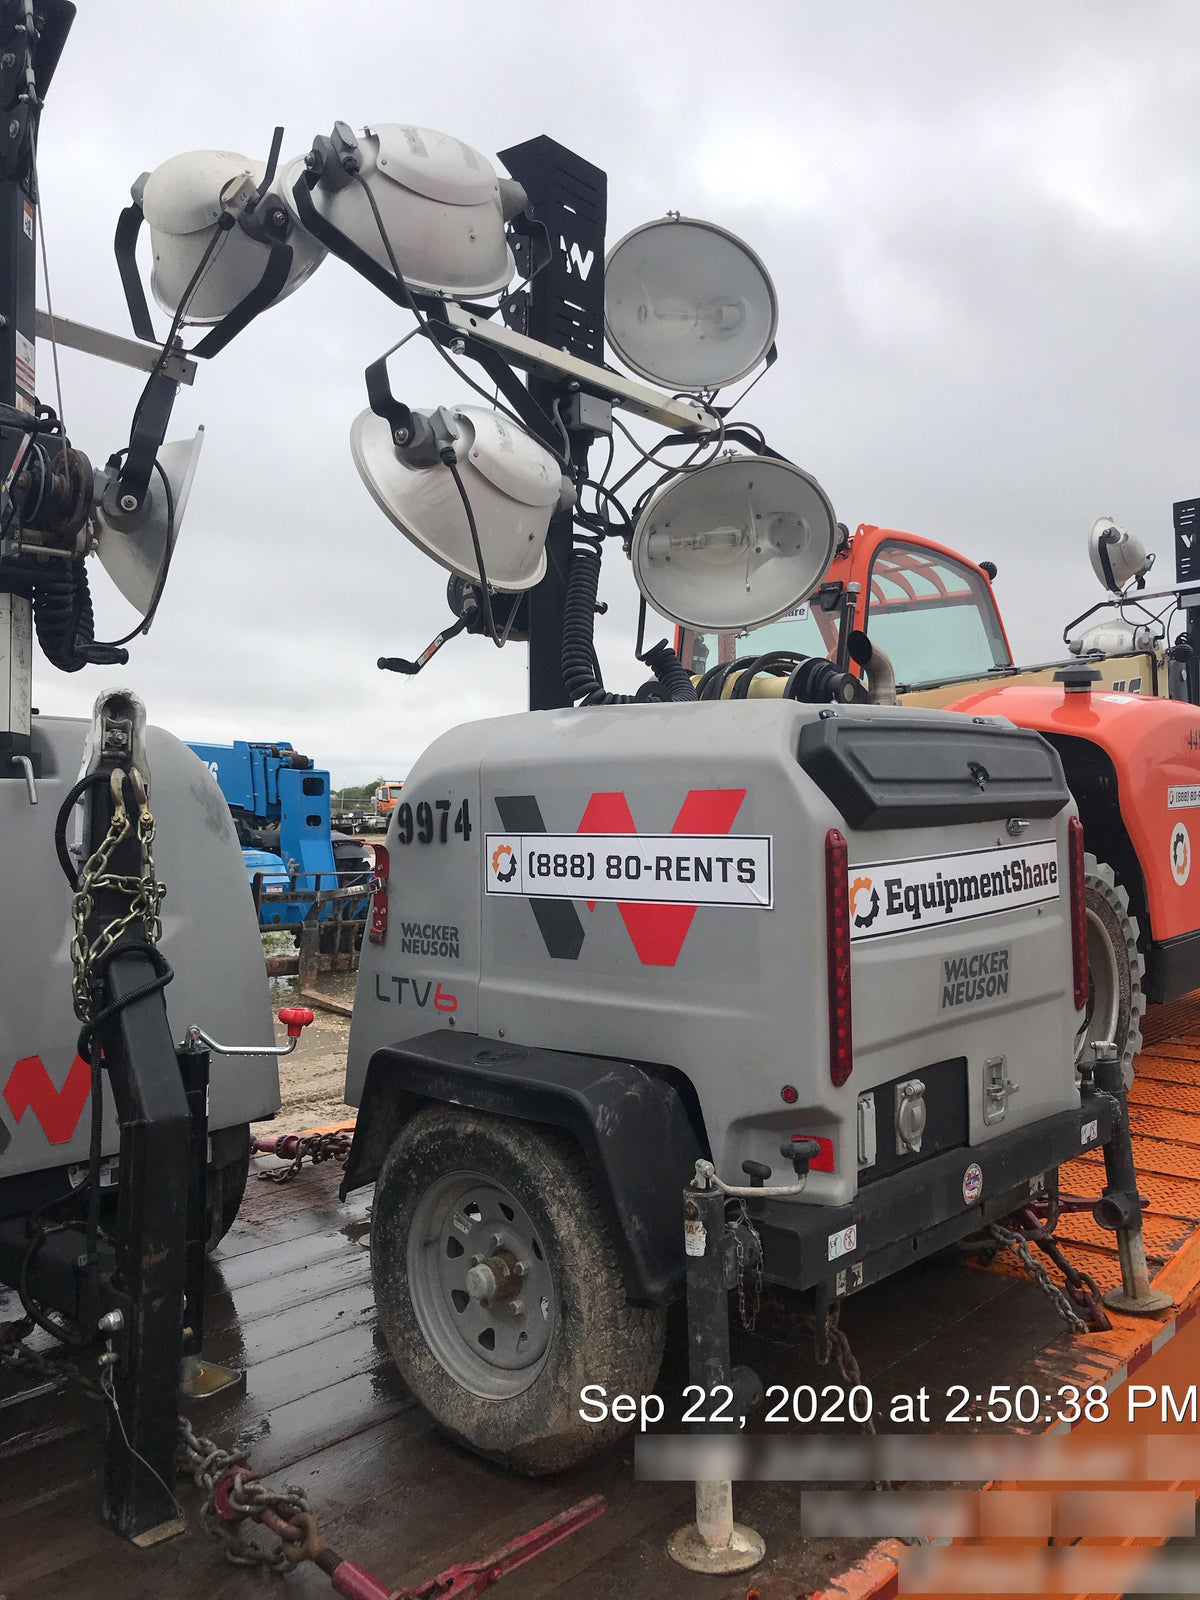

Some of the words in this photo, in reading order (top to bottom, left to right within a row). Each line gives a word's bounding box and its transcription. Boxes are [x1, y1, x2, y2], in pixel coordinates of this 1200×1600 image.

[1187, 729, 1200, 750] 44
[398, 799, 472, 844] 9974
[528, 852, 595, 881] (888)
[606, 855, 756, 884] 80-RENTS
[884, 859, 1057, 920] EquipmentShare
[401, 922, 459, 942] WACKER
[401, 938, 460, 959] NEUSON
[944, 949, 1009, 983] WACKER
[375, 974, 458, 1012] LTV6
[942, 973, 1009, 1008] NEUSON
